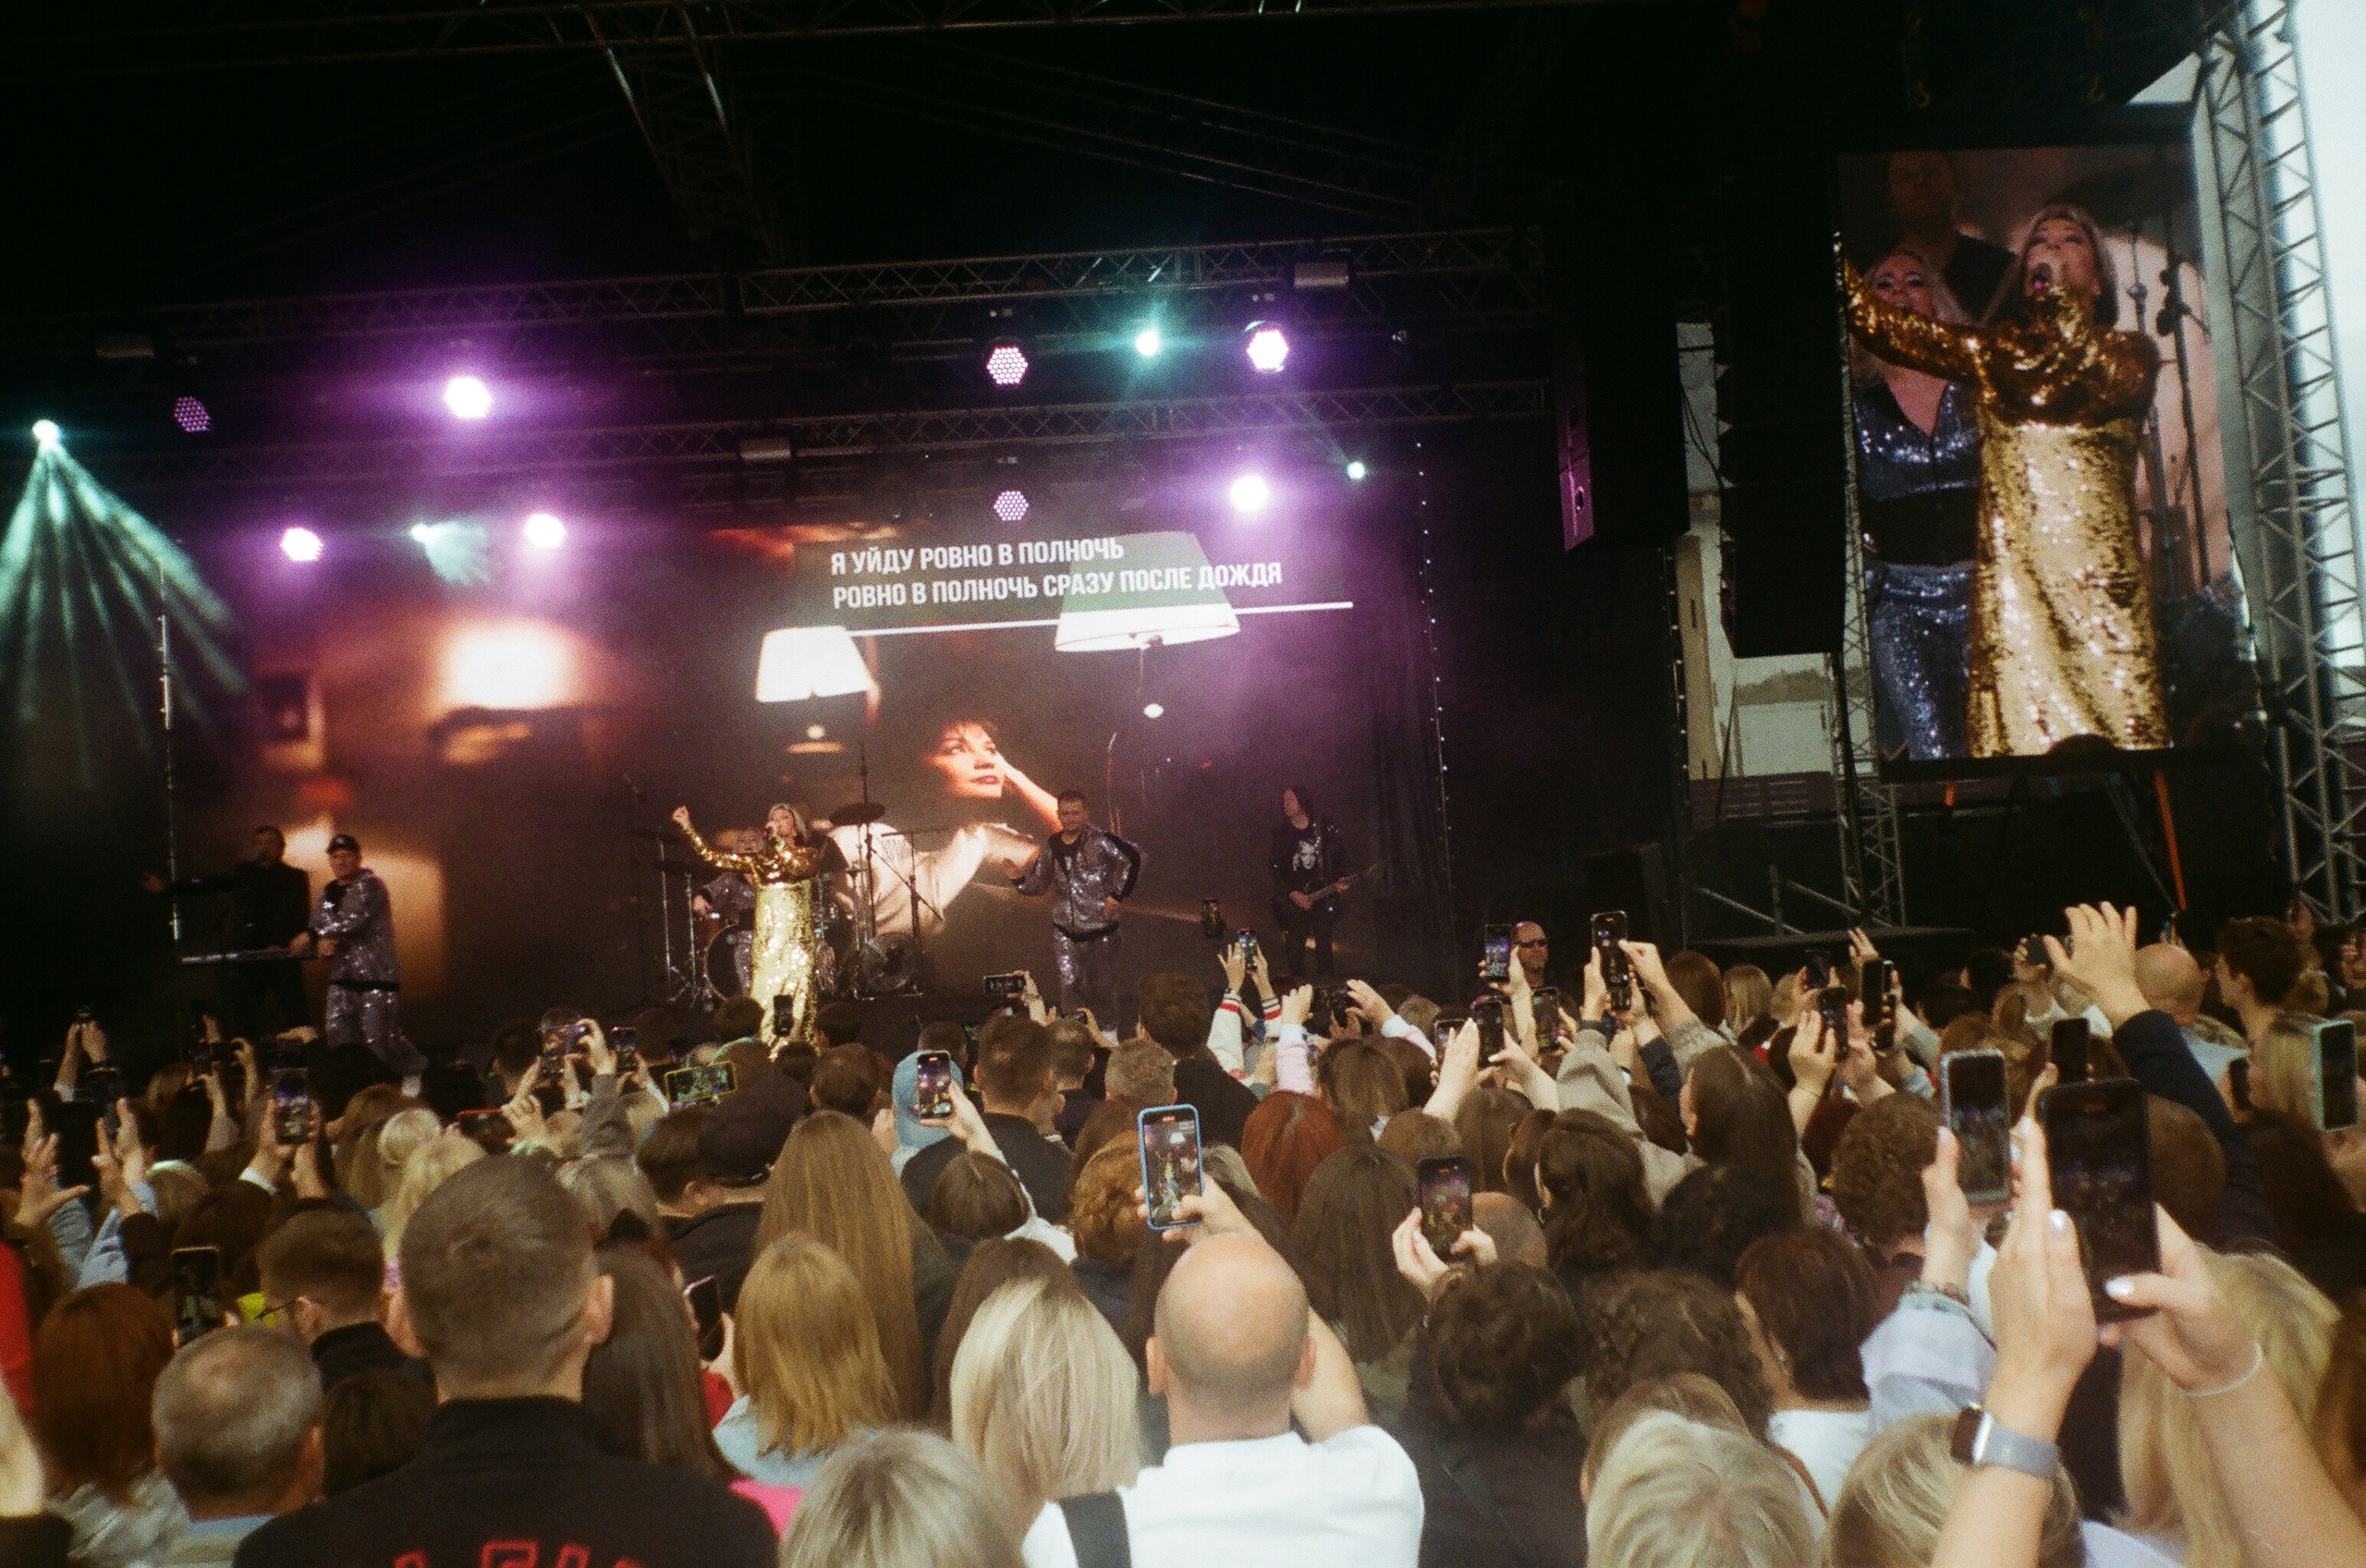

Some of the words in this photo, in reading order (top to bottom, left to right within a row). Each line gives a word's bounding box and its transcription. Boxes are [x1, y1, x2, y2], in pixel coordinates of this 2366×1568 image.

[831, 553, 846, 575] Я
[851, 547, 914, 575] УЙДУ
[921, 544, 992, 569] РОВНО
[998, 543, 1013, 565] В
[1018, 537, 1124, 564] ПОЛНОЧЬ
[833, 583, 906, 608] РОВНО
[912, 582, 926, 604] В
[932, 577, 1038, 602] ПОЛНОЧЬ
[1043, 572, 1114, 597] СРАЗУ
[1119, 567, 1192, 592] ПОСЛЕ
[1198, 563, 1282, 591] ДОЖДЯ
